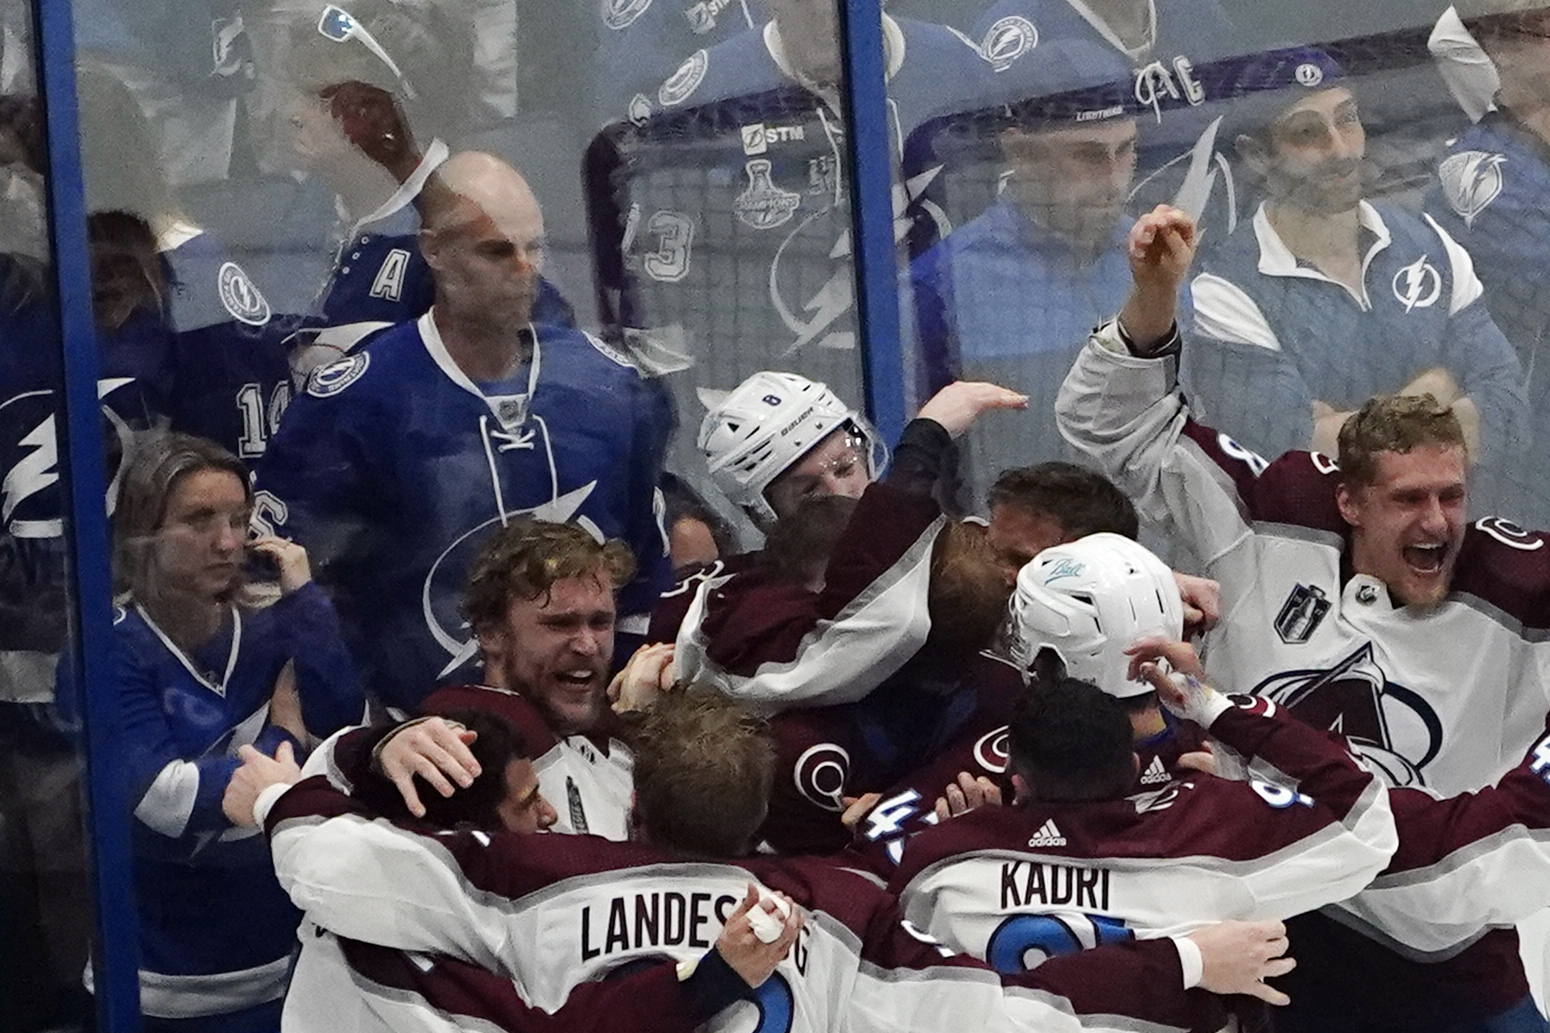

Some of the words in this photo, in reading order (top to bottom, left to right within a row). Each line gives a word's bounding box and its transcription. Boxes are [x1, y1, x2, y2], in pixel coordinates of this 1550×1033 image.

[369, 248, 412, 302] A
[1028, 836, 1067, 848] adidas
[1001, 860, 1110, 911] KADRI
